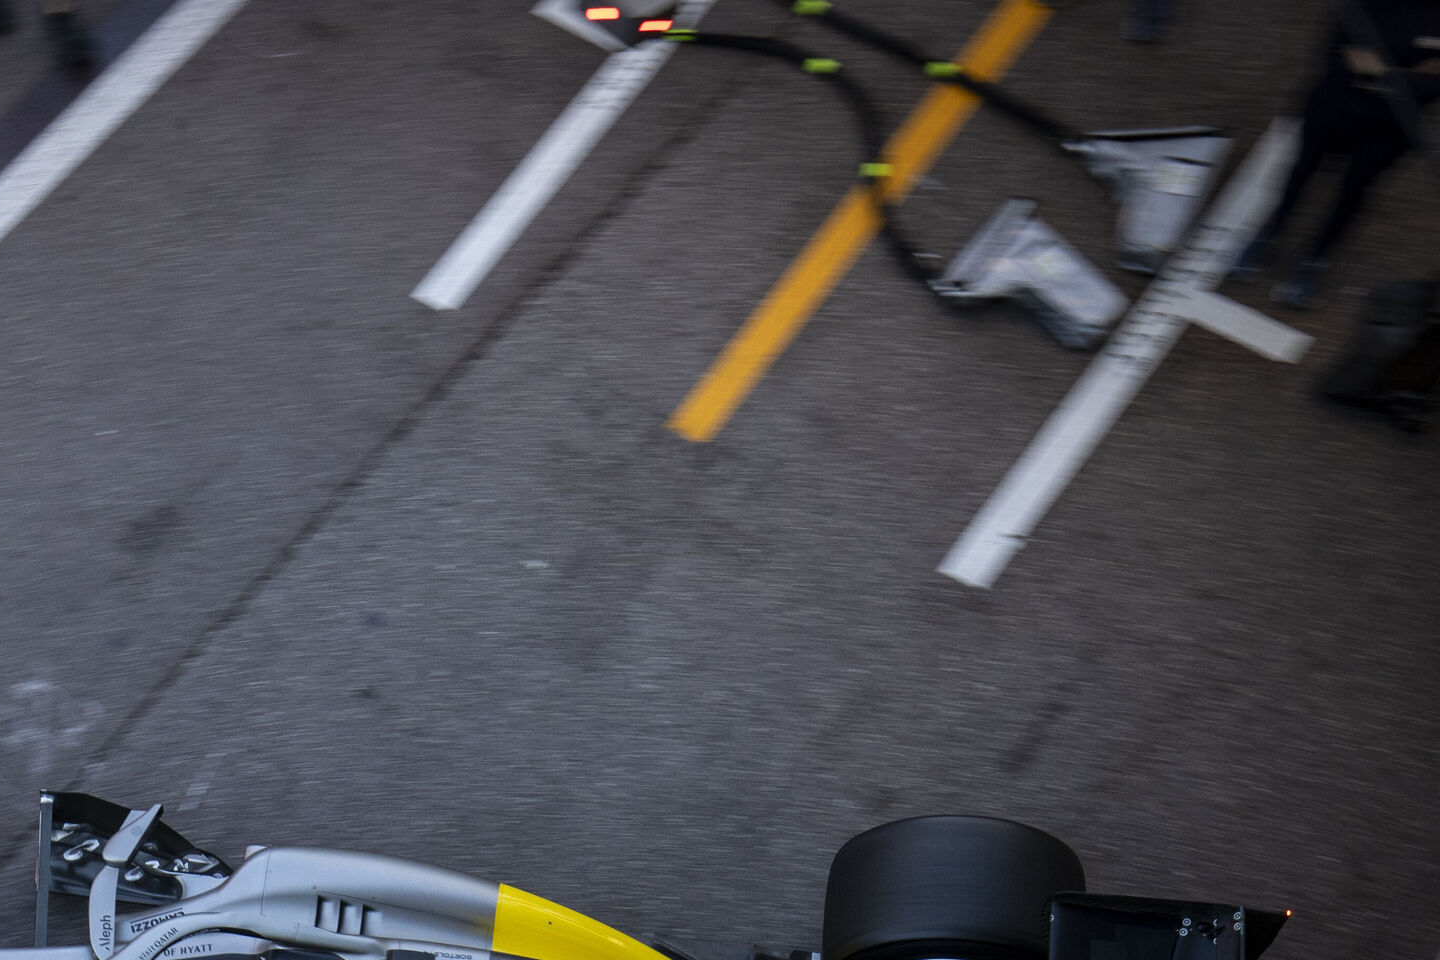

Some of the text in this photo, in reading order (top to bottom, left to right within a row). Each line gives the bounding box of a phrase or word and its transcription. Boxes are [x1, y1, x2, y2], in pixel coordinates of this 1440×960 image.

[99, 914, 113, 951] Aleph
[163, 944, 214, 957] OF HYATT
